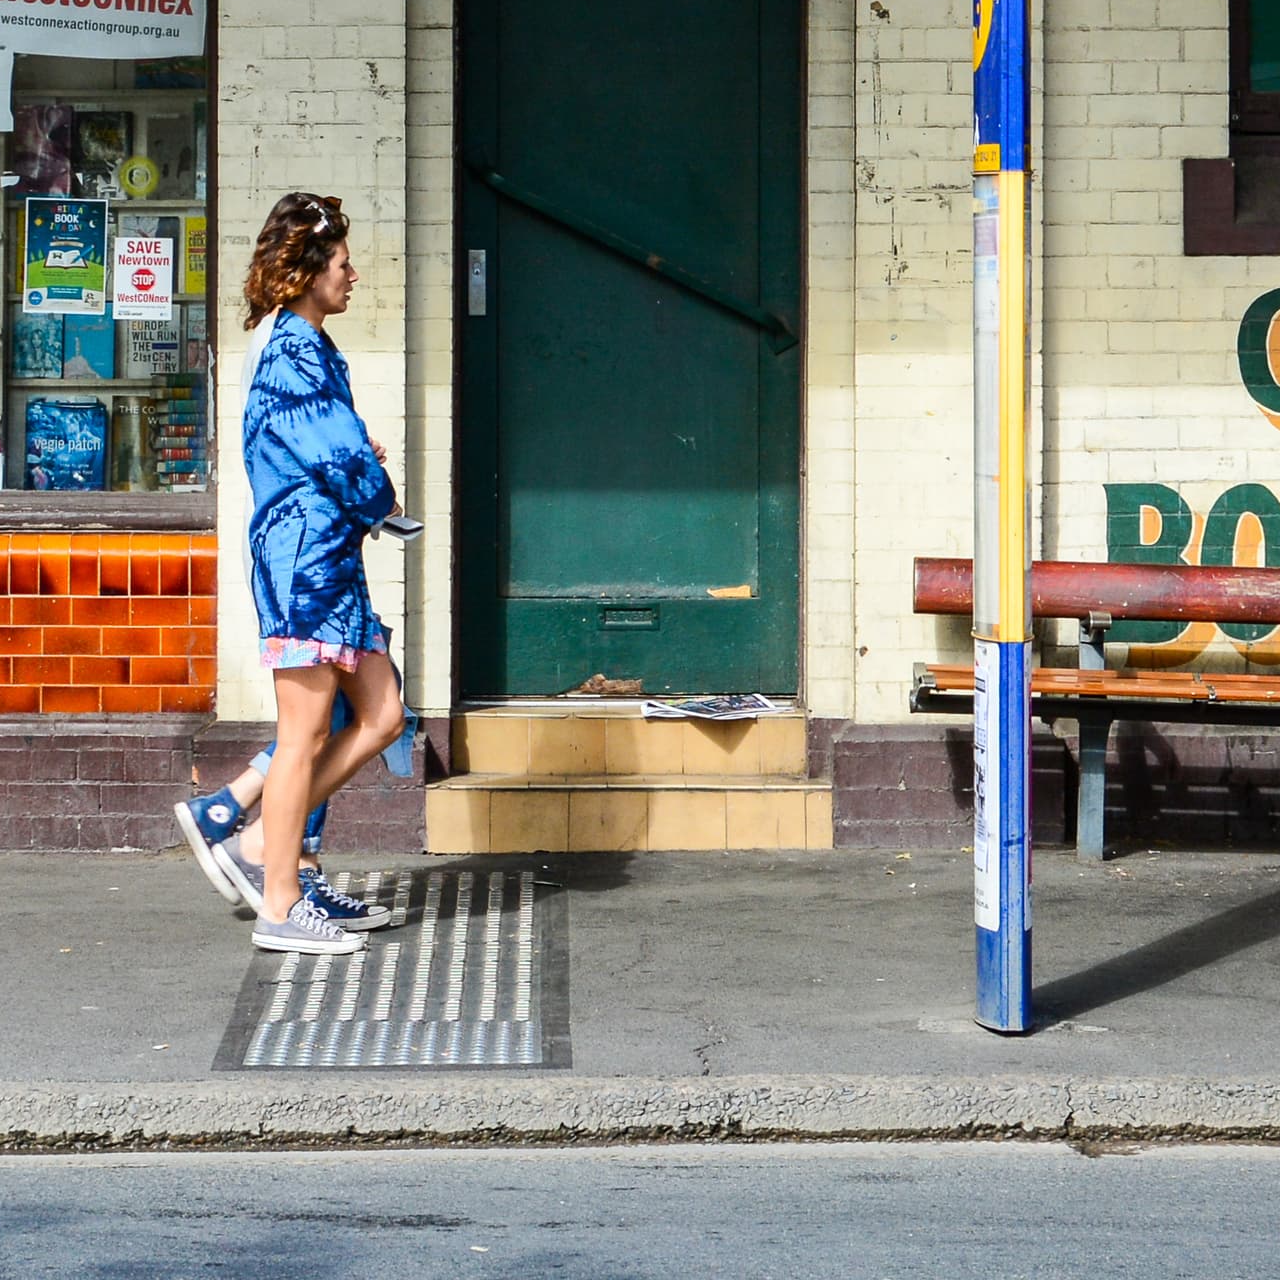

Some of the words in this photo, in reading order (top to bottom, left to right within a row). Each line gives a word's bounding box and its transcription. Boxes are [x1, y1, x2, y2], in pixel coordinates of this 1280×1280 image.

[1, 14, 180, 38] westconnexactiongroup.org.au
[127, 240, 162, 254] SAVE
[118, 254, 170, 266] Newtown
[132, 274, 154, 286] STOP
[117, 293, 169, 303] WestCONnex
[131, 320, 169, 331] EUROPE
[131, 331, 154, 341] WILL
[156, 331, 177, 341] RUN
[132, 341, 151, 351] THE
[34, 437, 64, 453] vegie
[68, 437, 102, 453] patch
